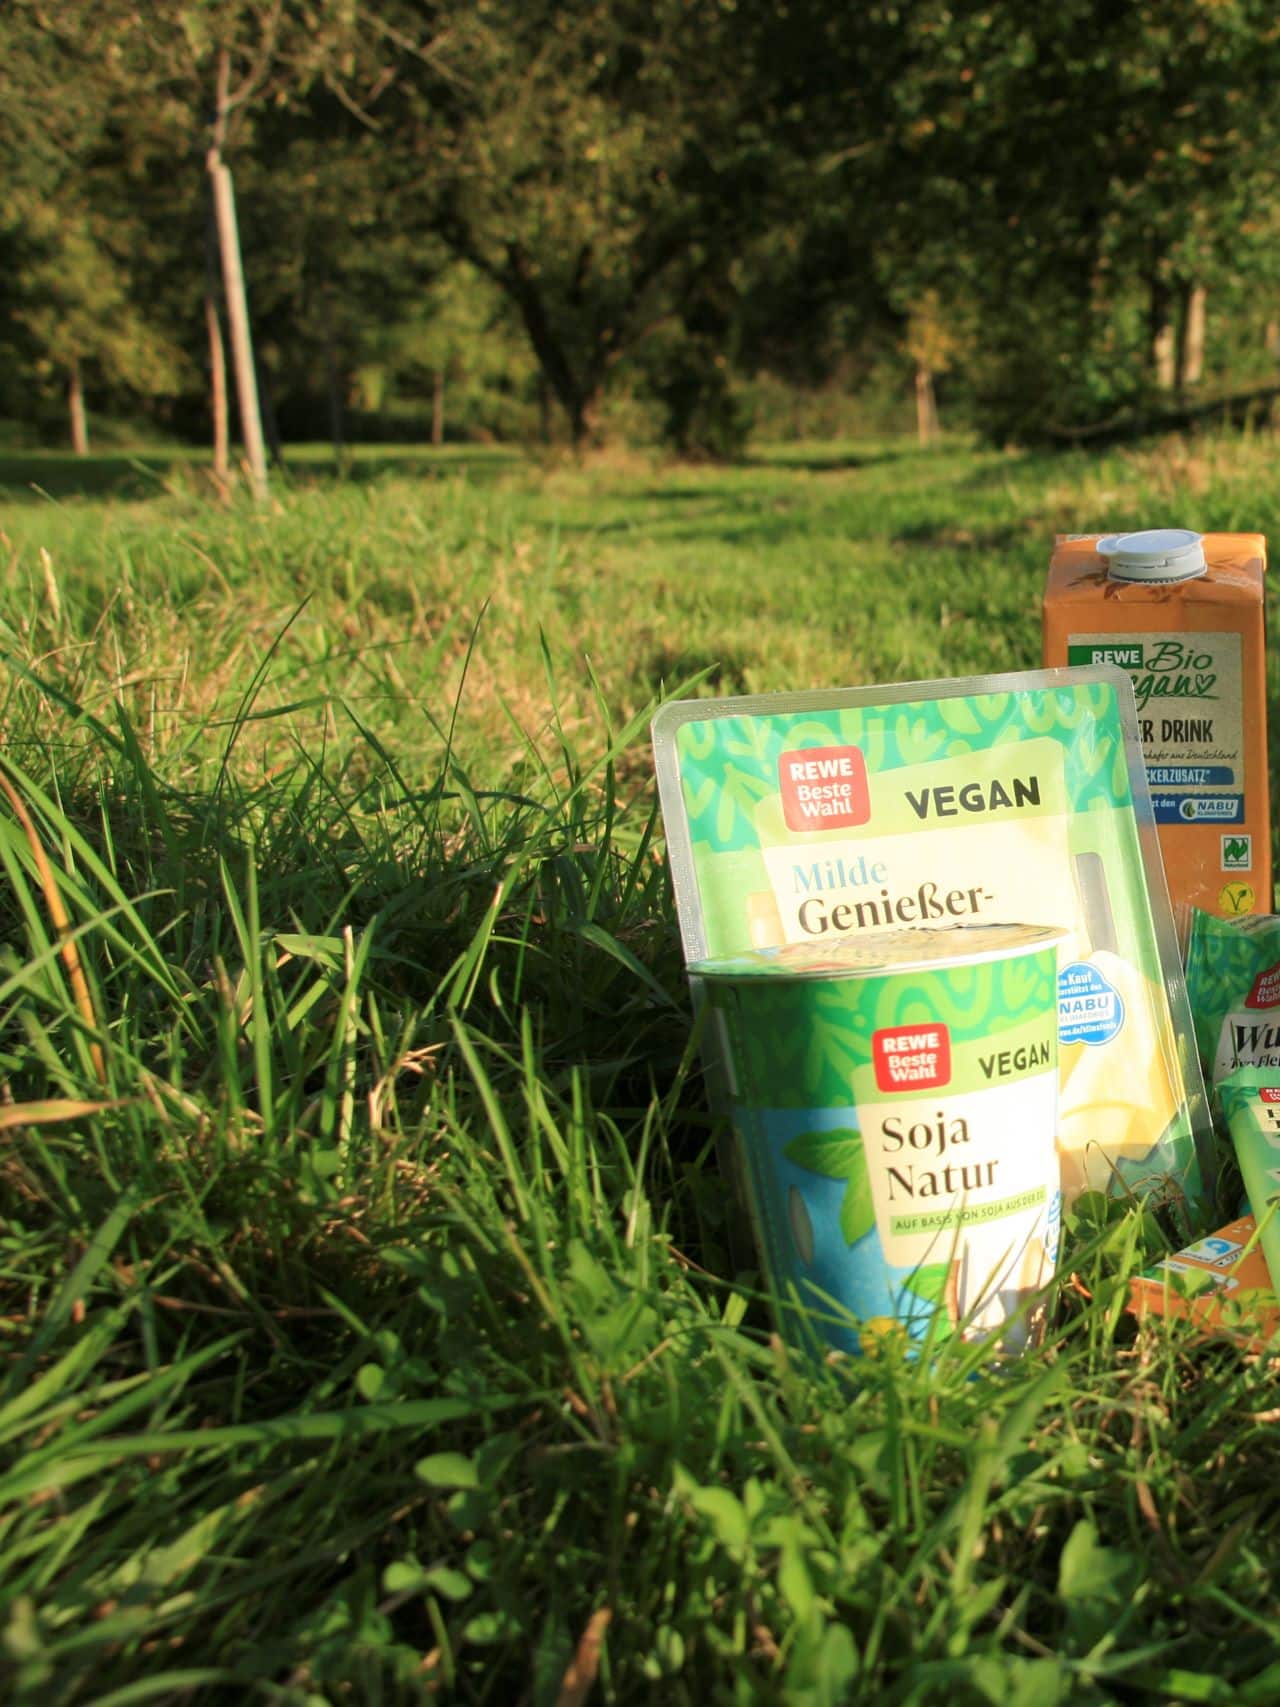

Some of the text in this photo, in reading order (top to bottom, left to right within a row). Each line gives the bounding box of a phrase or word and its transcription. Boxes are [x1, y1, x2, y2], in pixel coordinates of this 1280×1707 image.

[1091, 641, 1213, 672] REWE Bio
[1161, 719, 1213, 743] DRINK
[1186, 749, 1238, 760] Deutschland
[789, 758, 854, 781] REWE
[797, 782, 852, 801] Beste
[904, 776, 1041, 820] VEGAN
[799, 799, 854, 817] Wahl
[1198, 801, 1234, 810] NABU
[791, 856, 888, 894] Milde
[798, 881, 995, 935] Genießer-
[1060, 996, 1109, 1014] NABU
[882, 1032, 940, 1053] REWE
[888, 1052, 937, 1069] Beste
[978, 1040, 1050, 1079] VEGAN
[890, 1066, 937, 1082] Wahl
[881, 1111, 971, 1156] Soja
[886, 1159, 999, 1201] Natur
[895, 1219, 917, 1230] AUF
[981, 1204, 1004, 1217] SOJA
[1005, 1199, 1021, 1210] AUS
